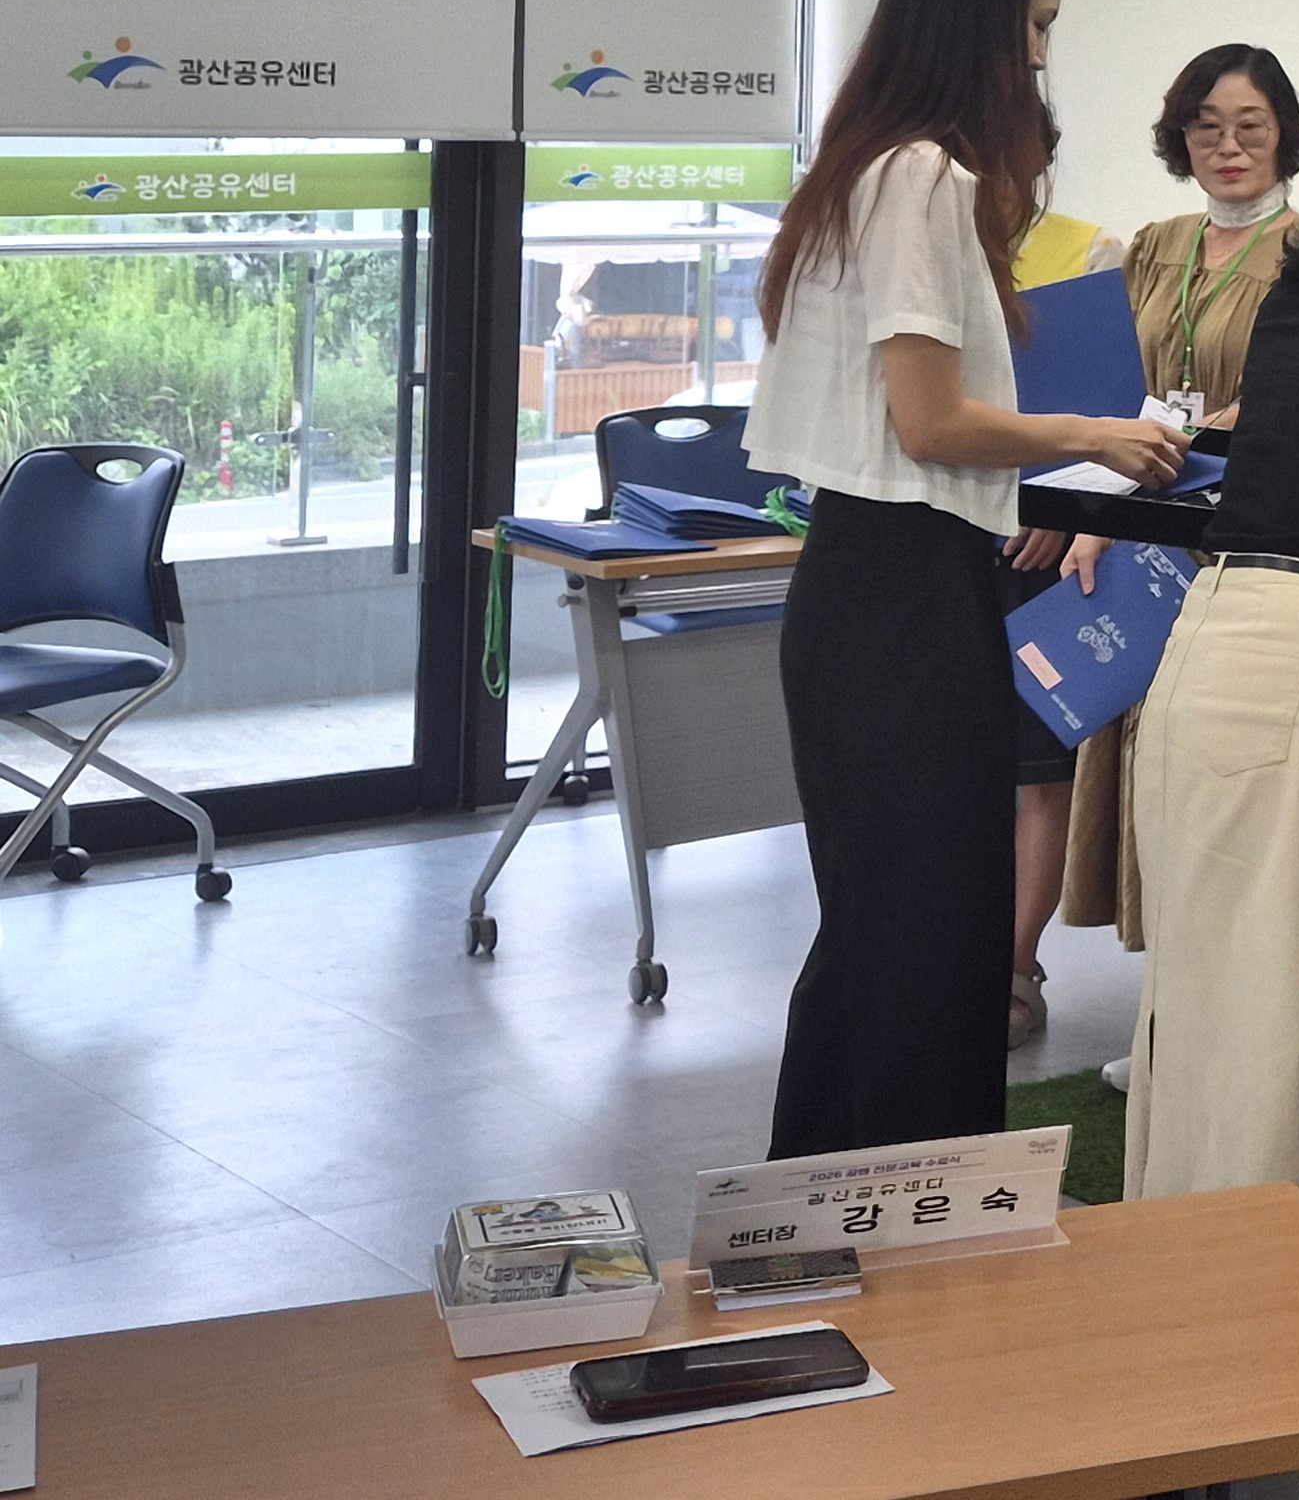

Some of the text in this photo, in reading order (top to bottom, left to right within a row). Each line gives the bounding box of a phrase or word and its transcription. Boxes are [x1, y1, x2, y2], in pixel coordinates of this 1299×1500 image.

[178, 59, 336, 87] 광산공유센터
[643, 70, 776, 96] 광산공유센터
[134, 172, 296, 201] 광산공유센터
[611, 164, 746, 190] 광산공유센터
[728, 1224, 798, 1249] 센터장
[484, 1263, 561, 1286] Bakery
